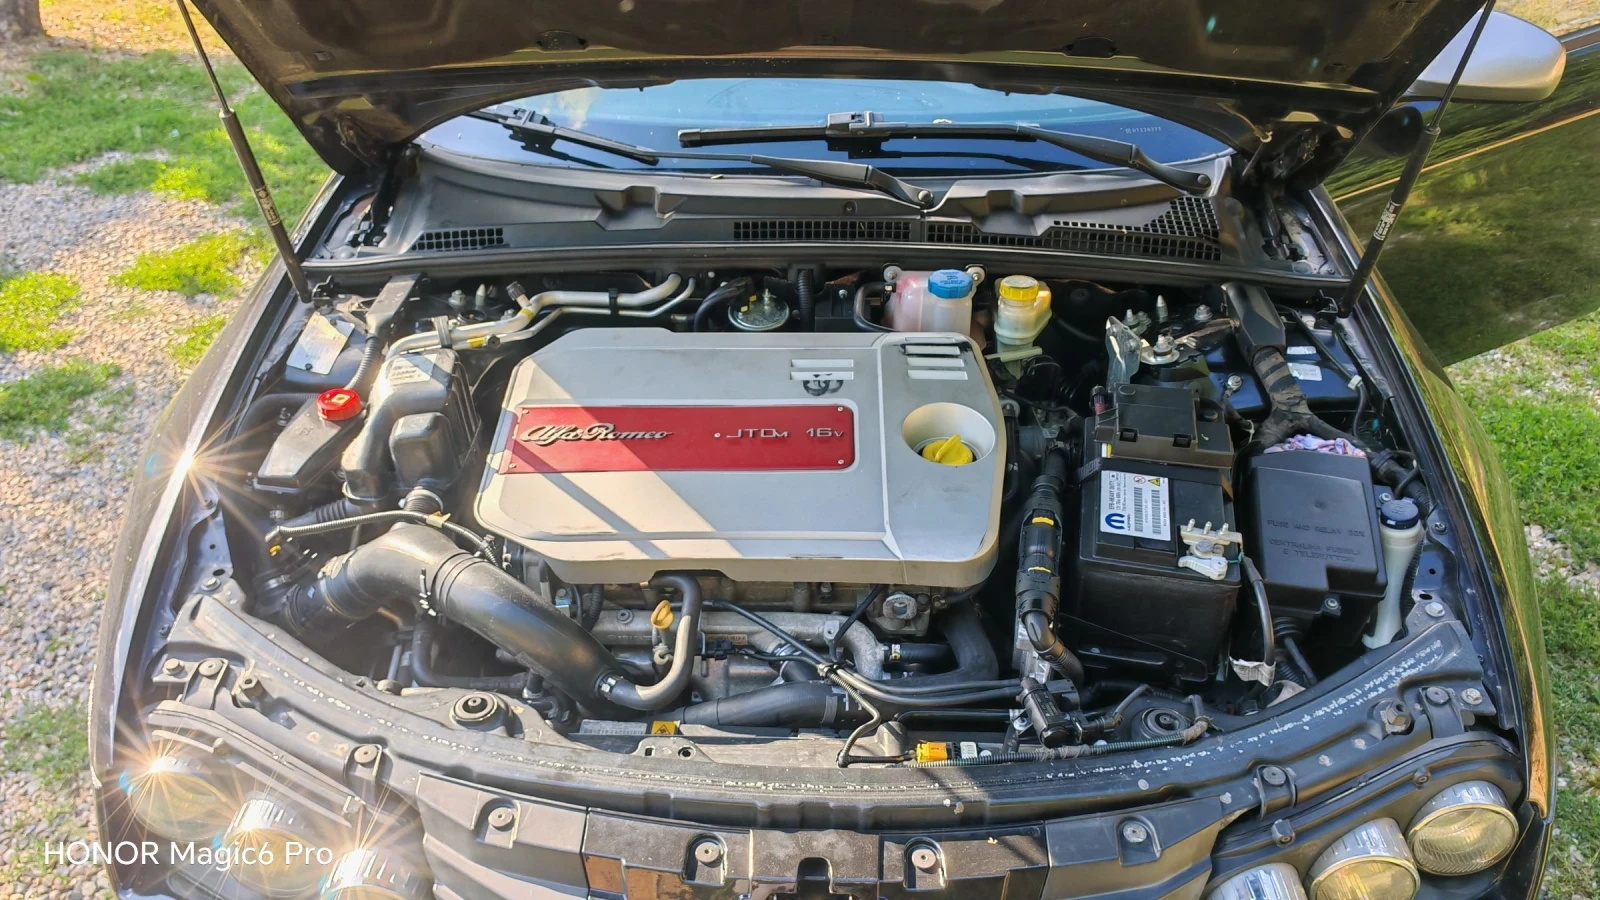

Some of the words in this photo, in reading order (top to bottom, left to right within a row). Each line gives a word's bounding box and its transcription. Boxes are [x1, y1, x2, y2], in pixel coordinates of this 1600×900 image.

[520, 423, 584, 446] Alfa
[583, 422, 672, 440] Romeo
[1267, 519, 1289, 529] FUSE
[1314, 526, 1342, 535] RELAY
